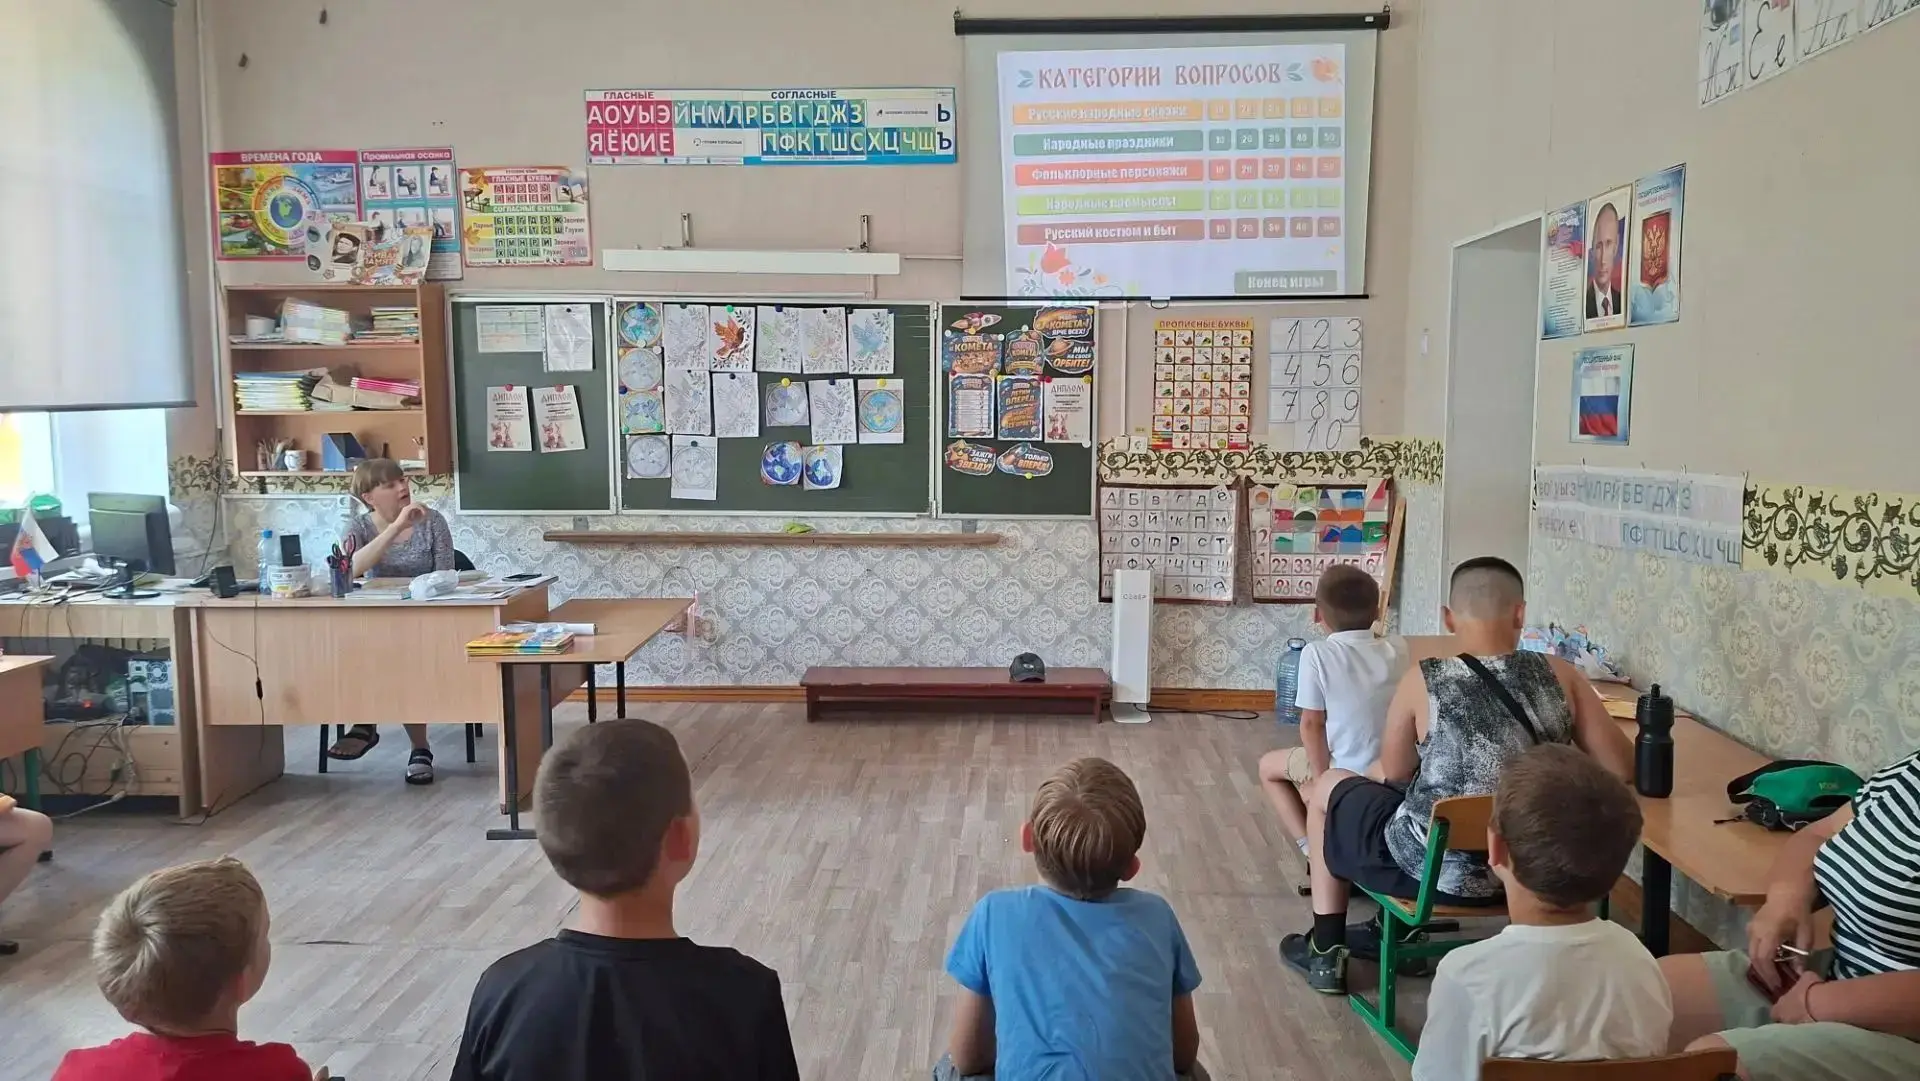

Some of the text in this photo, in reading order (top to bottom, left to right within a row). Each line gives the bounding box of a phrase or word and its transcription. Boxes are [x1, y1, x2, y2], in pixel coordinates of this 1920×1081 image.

[1038, 63, 1281, 89] КАТЕГОРИИ ВОПРОСОВ
[603, 91, 654, 100] ГЛАСНЫЕ
[771, 90, 837, 99] СОГЛАСНЫЕ
[1043, 135, 1174, 151] Народные праздники
[241, 152, 322, 162] ВРЕМЕНА ГОДА
[363, 151, 451, 161] Правильная осанка
[1120, 165, 1188, 178] персонажи
[1044, 224, 1176, 240] Русский костюм и быт
[1248, 276, 1324, 289] Конец игры
[1159, 320, 1249, 328] ПРОПИСНЫЕ БУКВЫ
[1287, 318, 1361, 350] 1 2 3
[1072, 346, 1089, 354] МЫ
[1284, 354, 1360, 387] 4 5 6
[1051, 384, 1085, 393] ДИПЛОМ
[1281, 390, 1359, 423] 7 8 9
[1306, 419, 1342, 450] 10
[1105, 491, 1117, 505] А
[1128, 492, 1139, 506] Б
